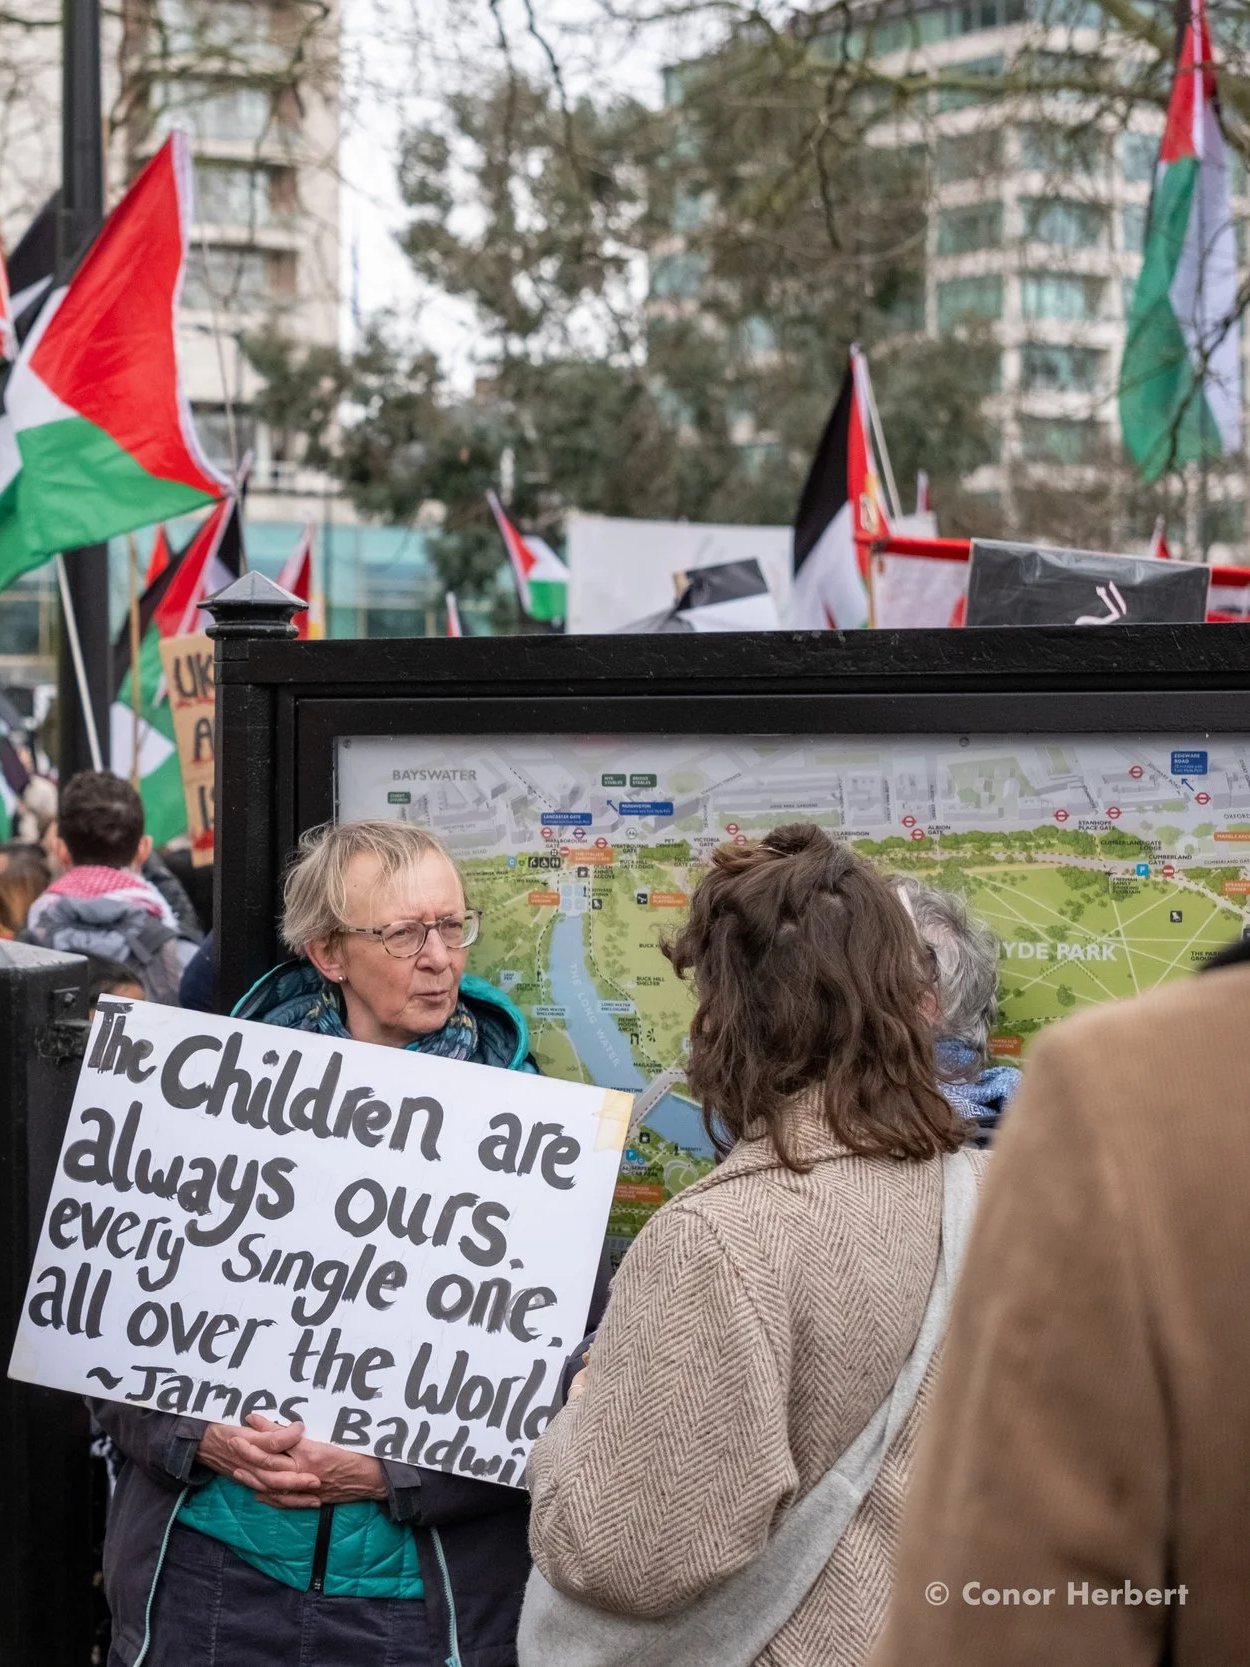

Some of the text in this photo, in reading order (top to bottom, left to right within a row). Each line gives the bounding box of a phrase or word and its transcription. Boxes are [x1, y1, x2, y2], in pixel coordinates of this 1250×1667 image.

[392, 769, 477, 781] BAYSWATER
[1000, 942, 1117, 961] YDE PARK
[578, 992, 597, 1024] LONG
[596, 1029, 620, 1068] WATER
[87, 1001, 582, 1190] The Children are
[63, 1100, 524, 1270] always ours.
[49, 1197, 185, 1291] every
[426, 1273, 564, 1348] one.
[28, 1263, 112, 1339] all
[127, 1302, 277, 1370] over
[288, 1327, 396, 1400] the
[330, 1407, 528, 1490] Baldwi
